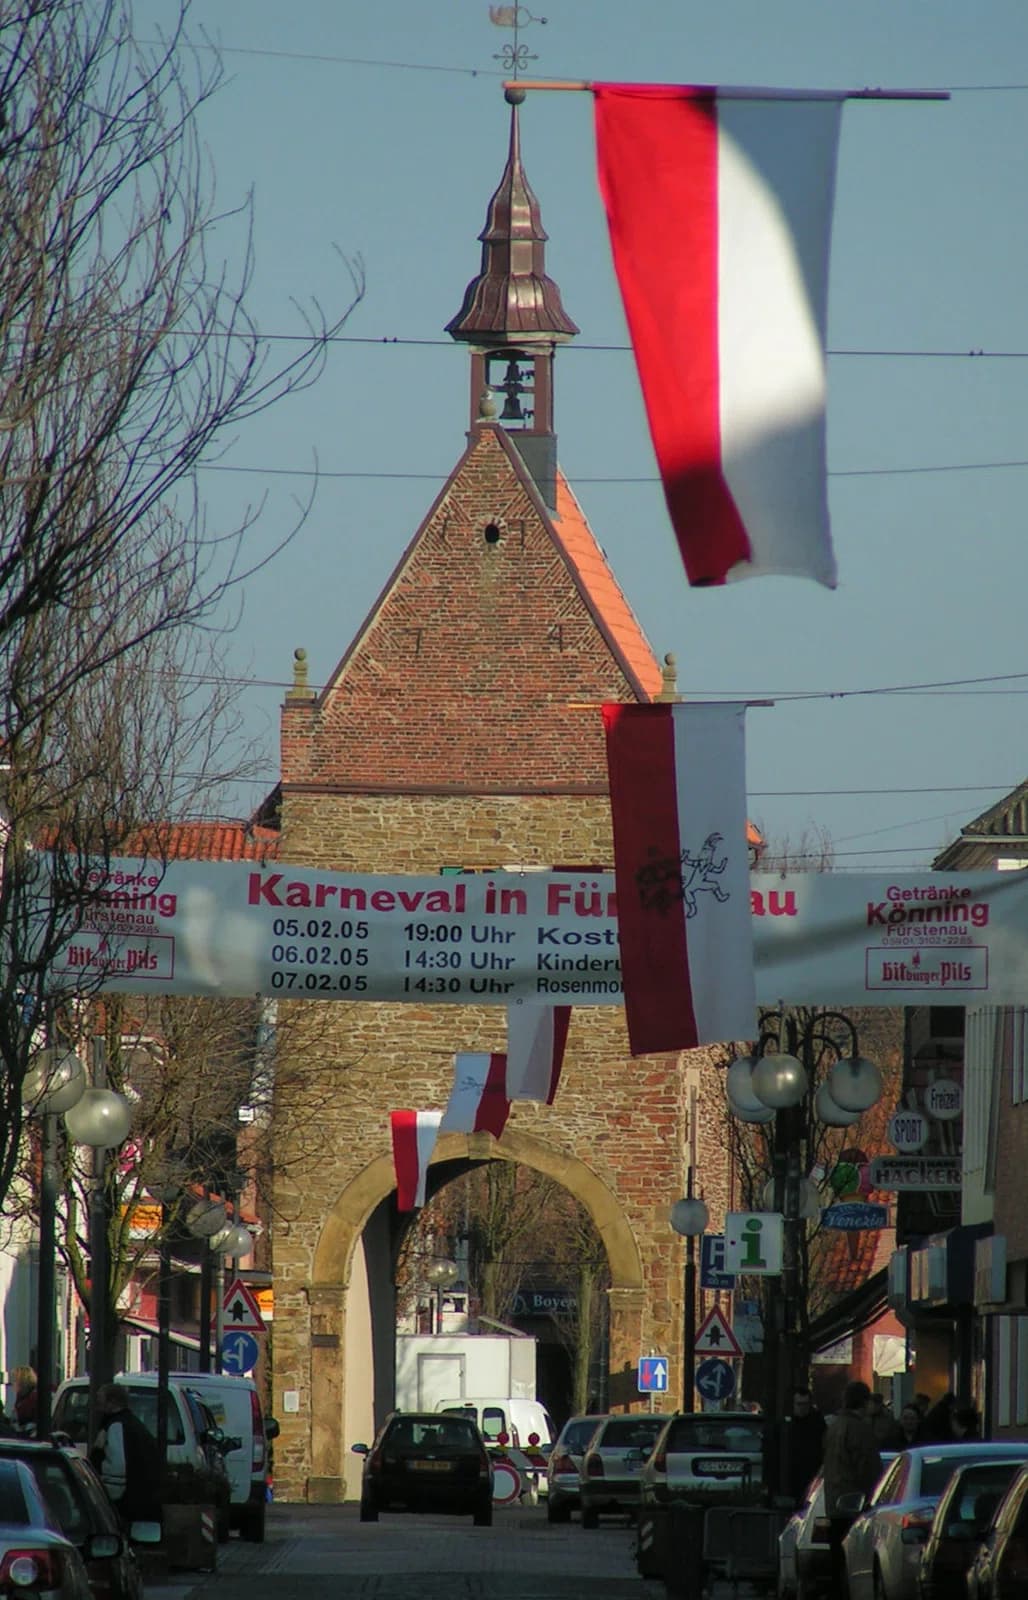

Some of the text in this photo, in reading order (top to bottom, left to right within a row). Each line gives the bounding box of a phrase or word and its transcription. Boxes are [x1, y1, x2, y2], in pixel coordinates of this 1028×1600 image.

[248, 873, 466, 913] Karneval
[485, 881, 527, 914] in
[886, 885, 972, 901] Getränke
[867, 901, 990, 927] Könning
[272, 919, 620, 946] 05.02.05 19:00 Uhr Kost
[887, 924, 968, 937] Fürstenau
[271, 945, 369, 966] 06.02.05
[404, 950, 462, 969] 14:30
[471, 952, 516, 970] Uhr
[271, 971, 368, 992] 07.02.05
[404, 976, 461, 993] 14:30
[470, 977, 515, 994] Uhr
[940, 961, 972, 986] Pils
[895, 1120, 922, 1142] SPORT
[824, 1210, 886, 1229] Venezia
